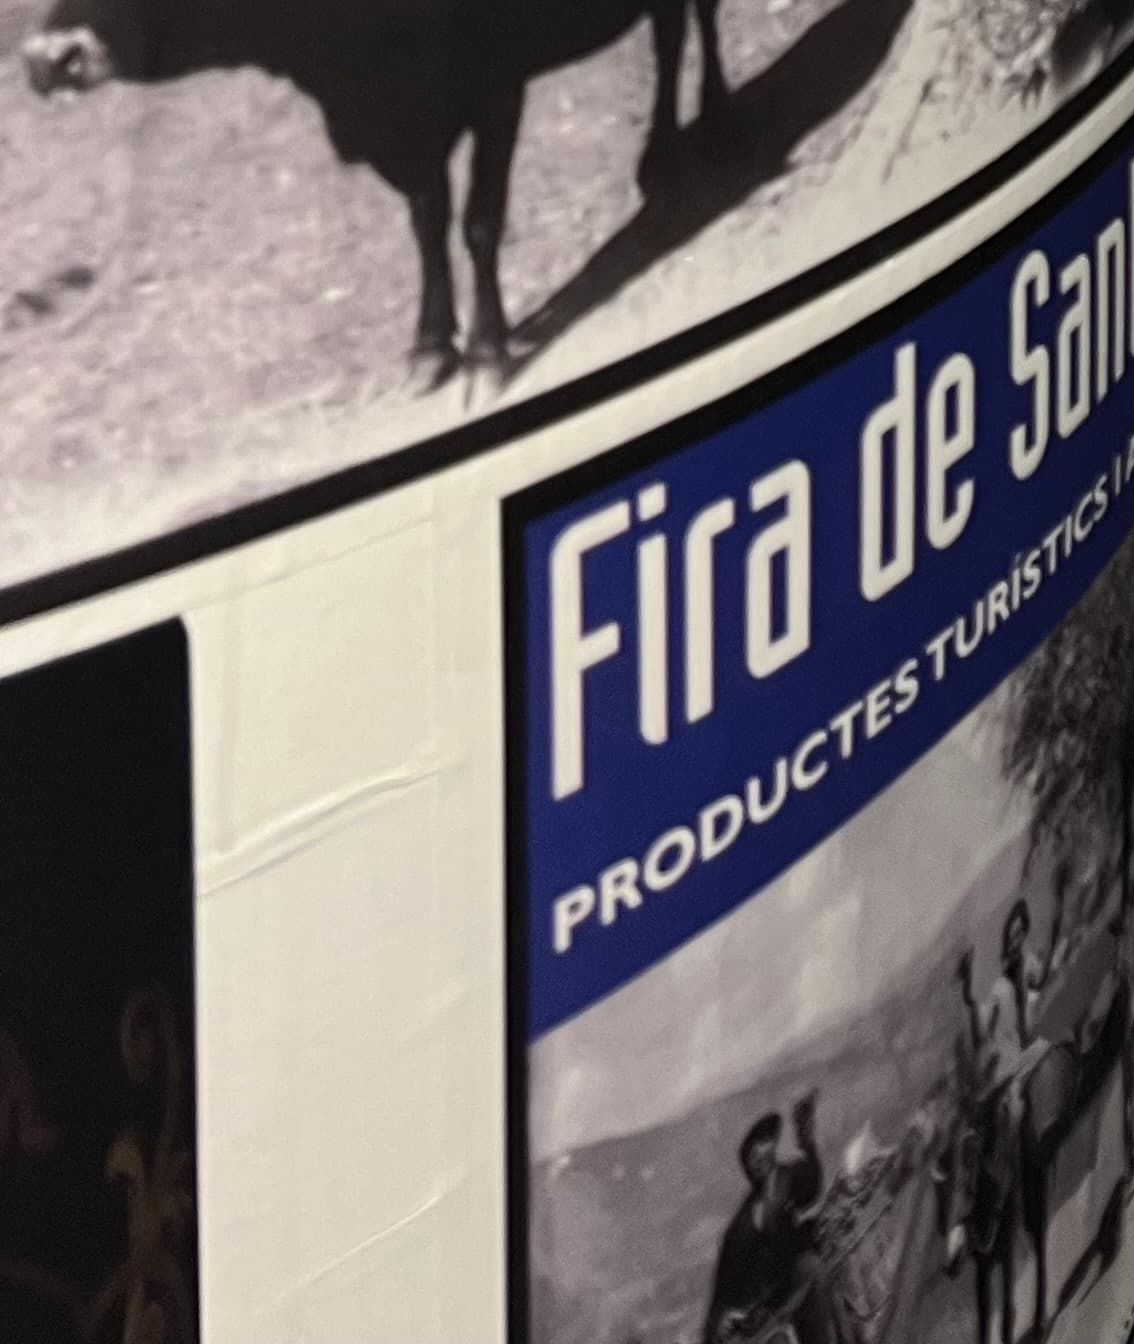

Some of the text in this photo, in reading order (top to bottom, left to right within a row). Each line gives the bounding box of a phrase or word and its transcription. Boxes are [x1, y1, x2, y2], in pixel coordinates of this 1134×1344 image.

[550, 480, 812, 803] Fira
[858, 339, 977, 603] de
[551, 657, 920, 955] PRODUCTES
[925, 473, 1109, 682] TURÍSTICS
[1114, 454, 1122, 497] I
